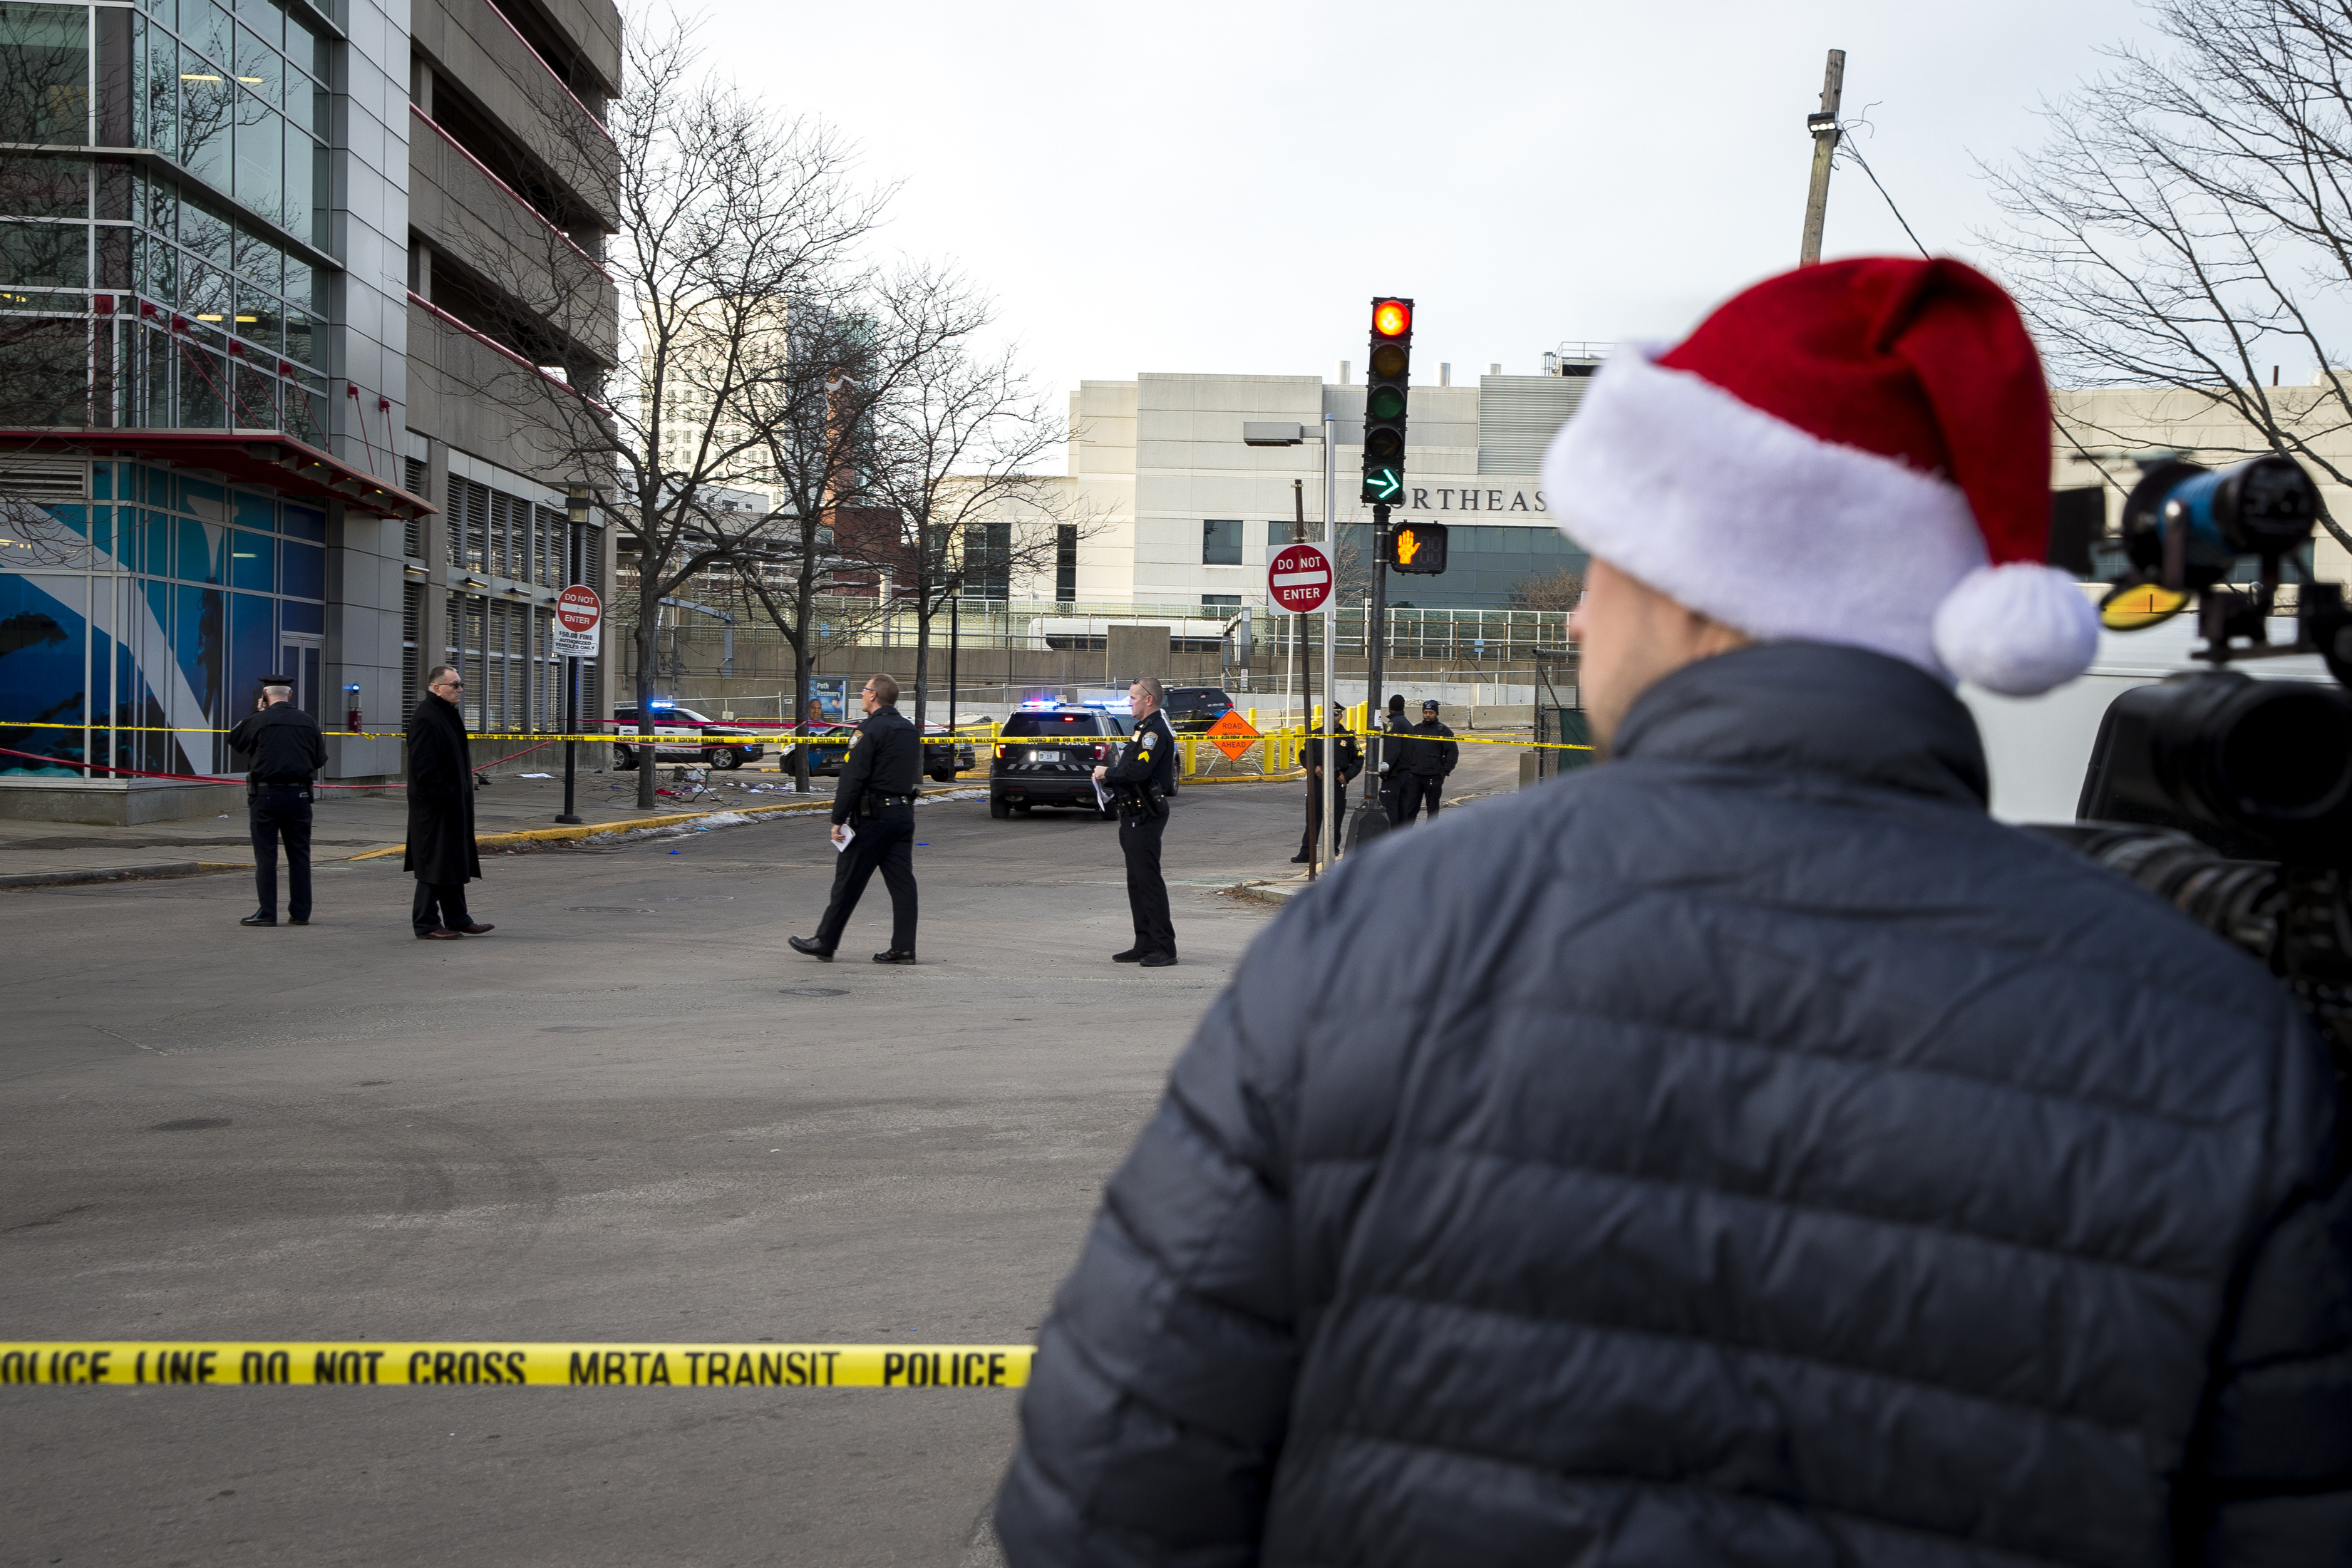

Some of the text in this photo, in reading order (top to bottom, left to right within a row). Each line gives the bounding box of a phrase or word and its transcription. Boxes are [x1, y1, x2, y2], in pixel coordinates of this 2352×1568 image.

[1361, 488, 1548, 512] RTHEAS
[1278, 557, 1321, 569] DO NOT
[564, 593, 594, 604] DO NOT
[1284, 588, 1320, 600] ENTER
[564, 614, 590, 624] ENTER
[817, 690, 841, 698] Recovery
[0, 1351, 1007, 1387] OLICE LINE DO NOT CROSS MBTA TRANSIT POLICE
